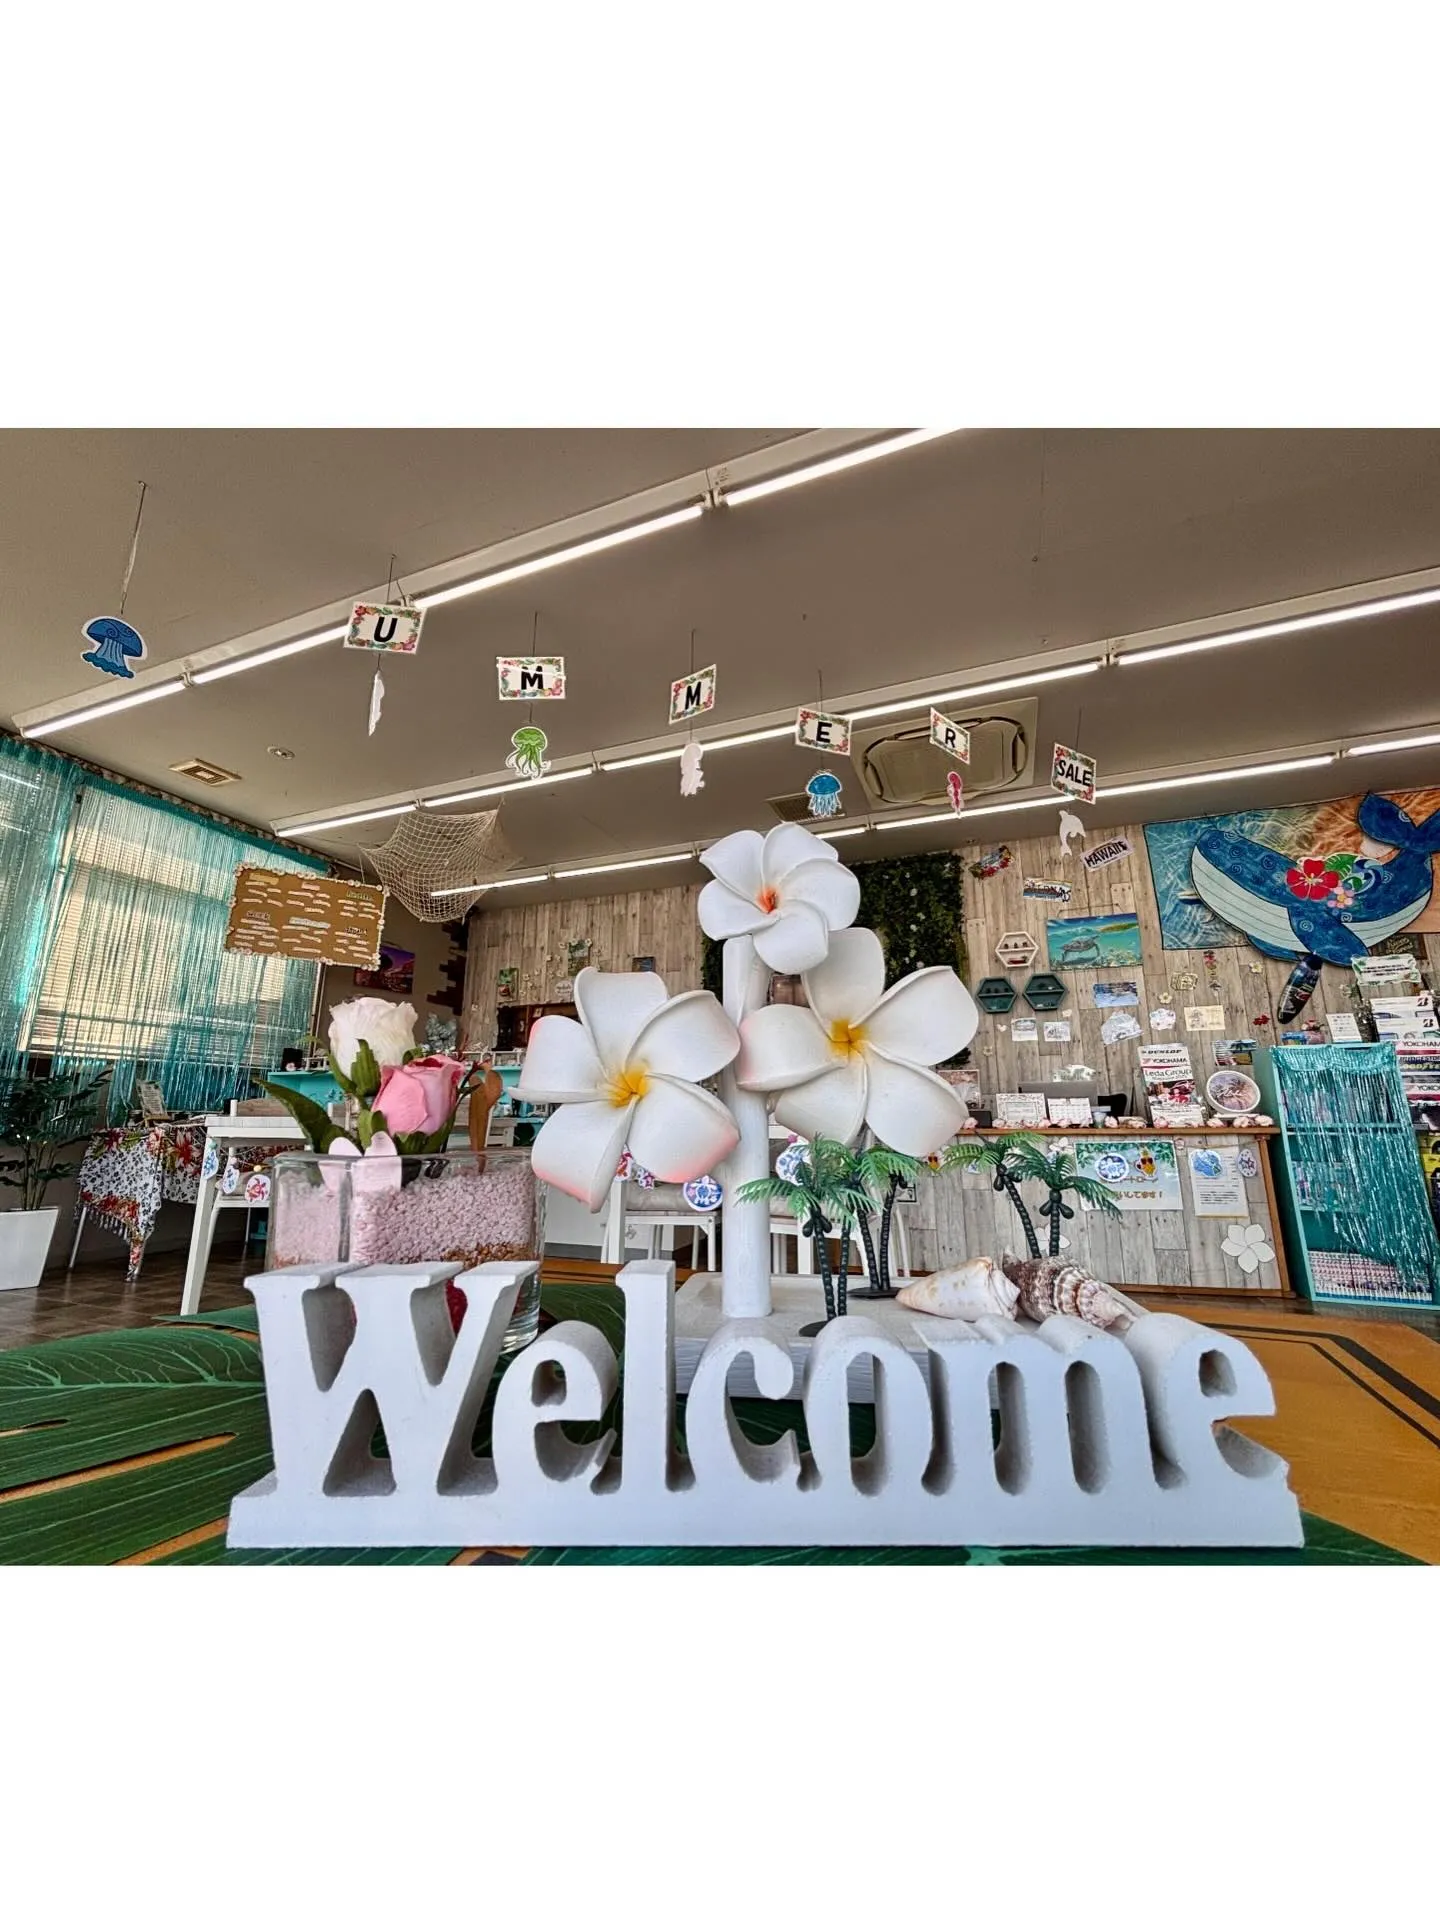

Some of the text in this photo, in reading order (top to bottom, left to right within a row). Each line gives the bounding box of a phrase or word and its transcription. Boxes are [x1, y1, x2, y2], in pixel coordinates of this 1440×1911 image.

[373, 616, 398, 643] U
[520, 665, 544, 691] M
[685, 682, 702, 710] M
[815, 721, 832, 744] E
[944, 727, 957, 749] R
[1056, 759, 1092, 787] SALE
[244, 1258, 1289, 1496] Welcome
